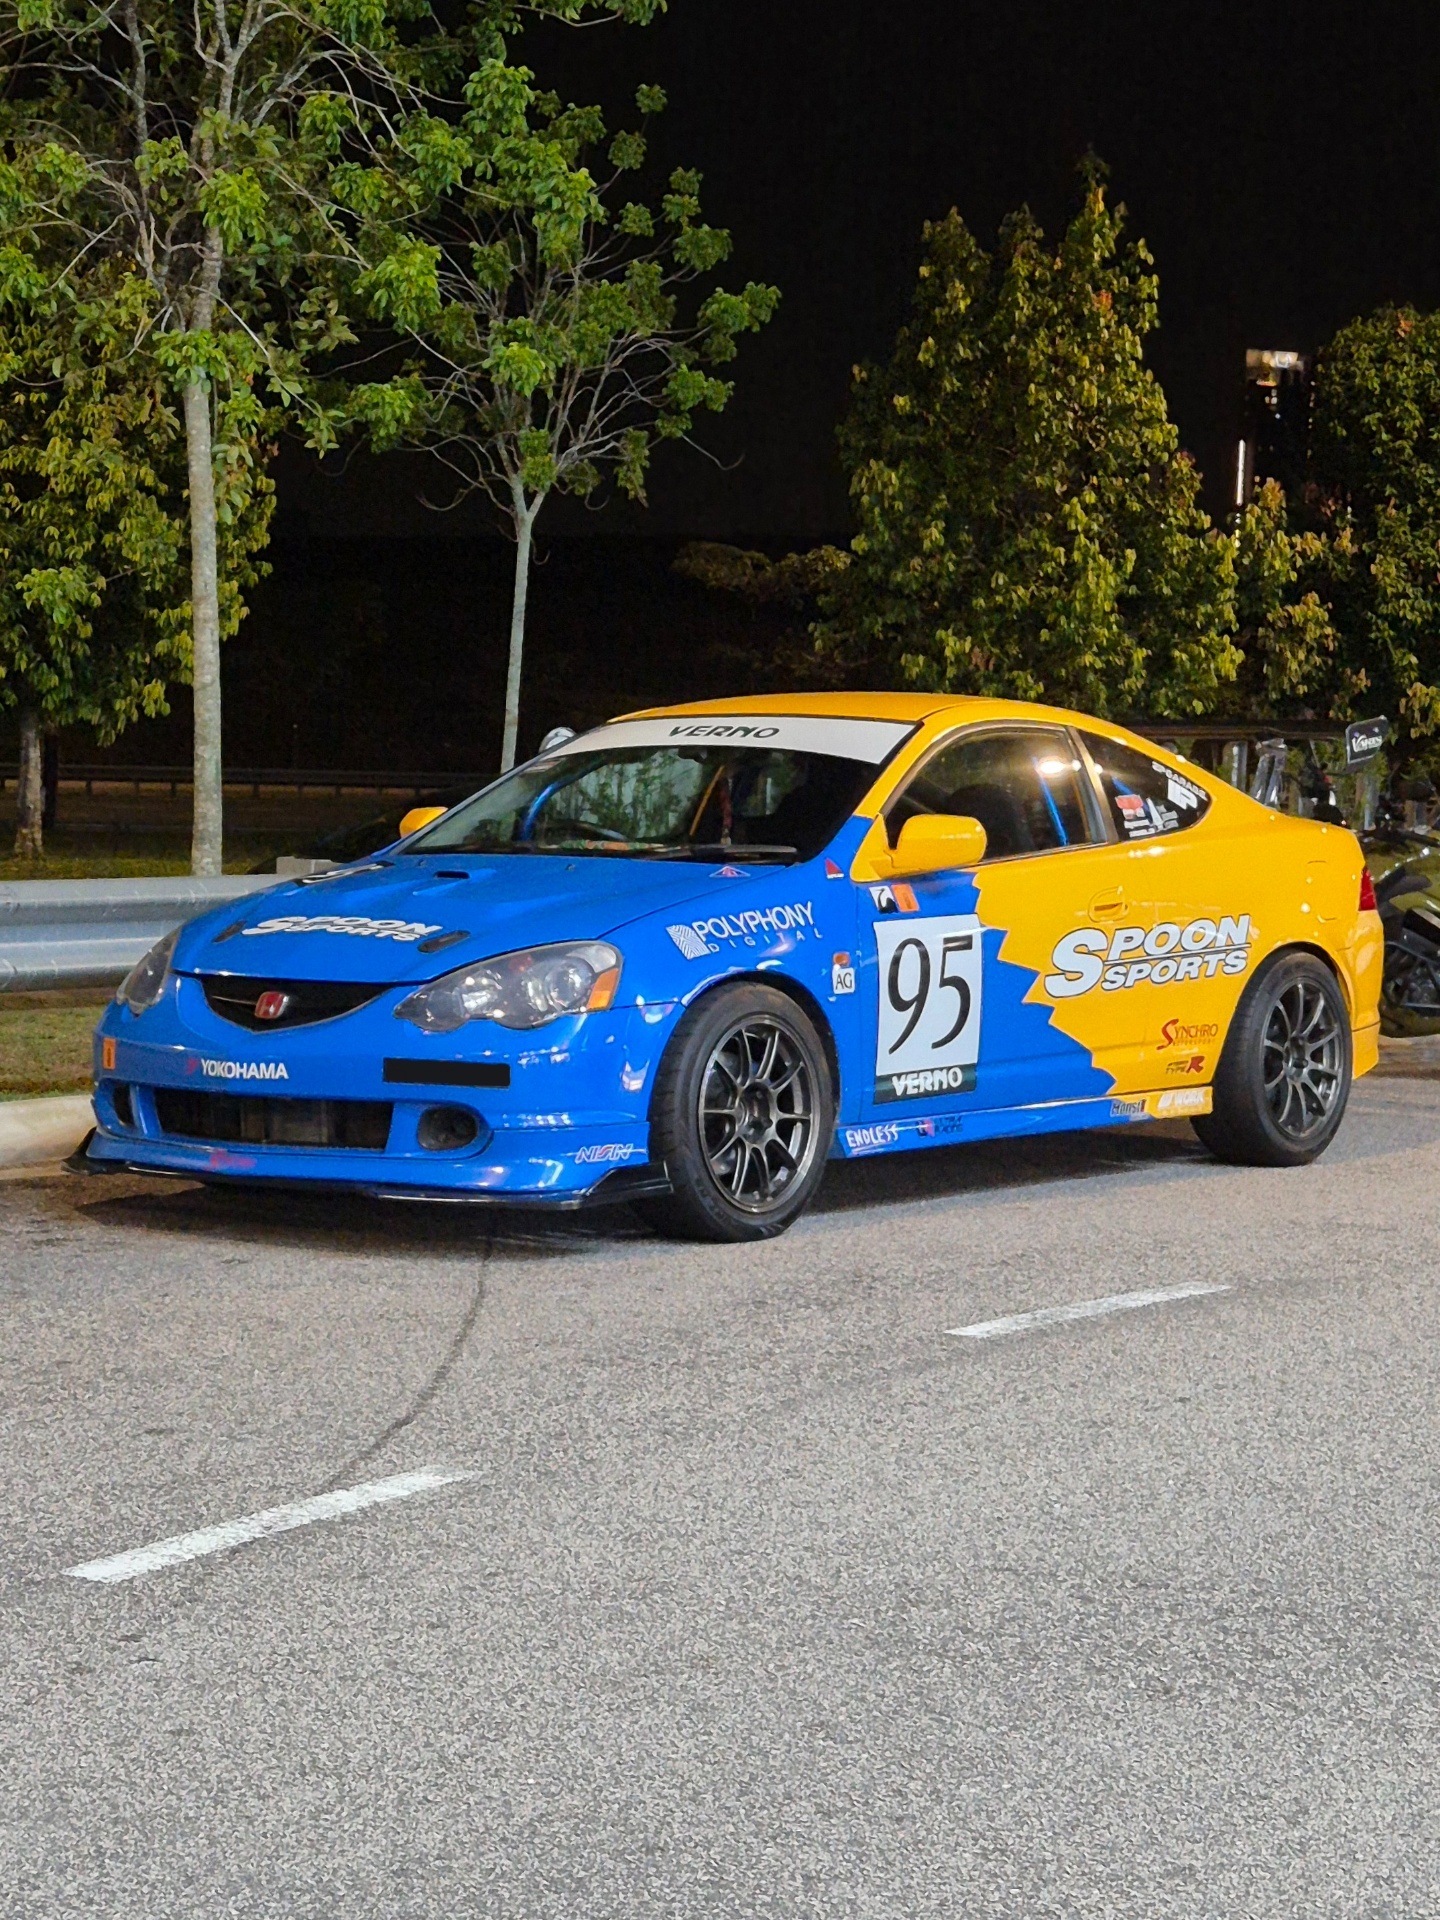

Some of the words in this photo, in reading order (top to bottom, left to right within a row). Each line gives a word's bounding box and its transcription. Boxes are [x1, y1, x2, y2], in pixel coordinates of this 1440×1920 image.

[669, 725, 780, 738] VERNO
[241, 916, 443, 936] SPOON
[284, 924, 420, 942] SPORTS
[693, 901, 814, 941] POLYPHONY
[709, 928, 823, 953] DIGITAL
[1044, 914, 1252, 998] SPOON
[835, 972, 853, 990] AG
[1101, 948, 1249, 991] SPORTS
[887, 935, 973, 1056] 95
[1156, 1018, 1219, 1050] SYNCHRO
[201, 1059, 289, 1080] YOKOHAMA
[892, 1066, 963, 1097] VERNO
[845, 1123, 899, 1148] ENDLESS
